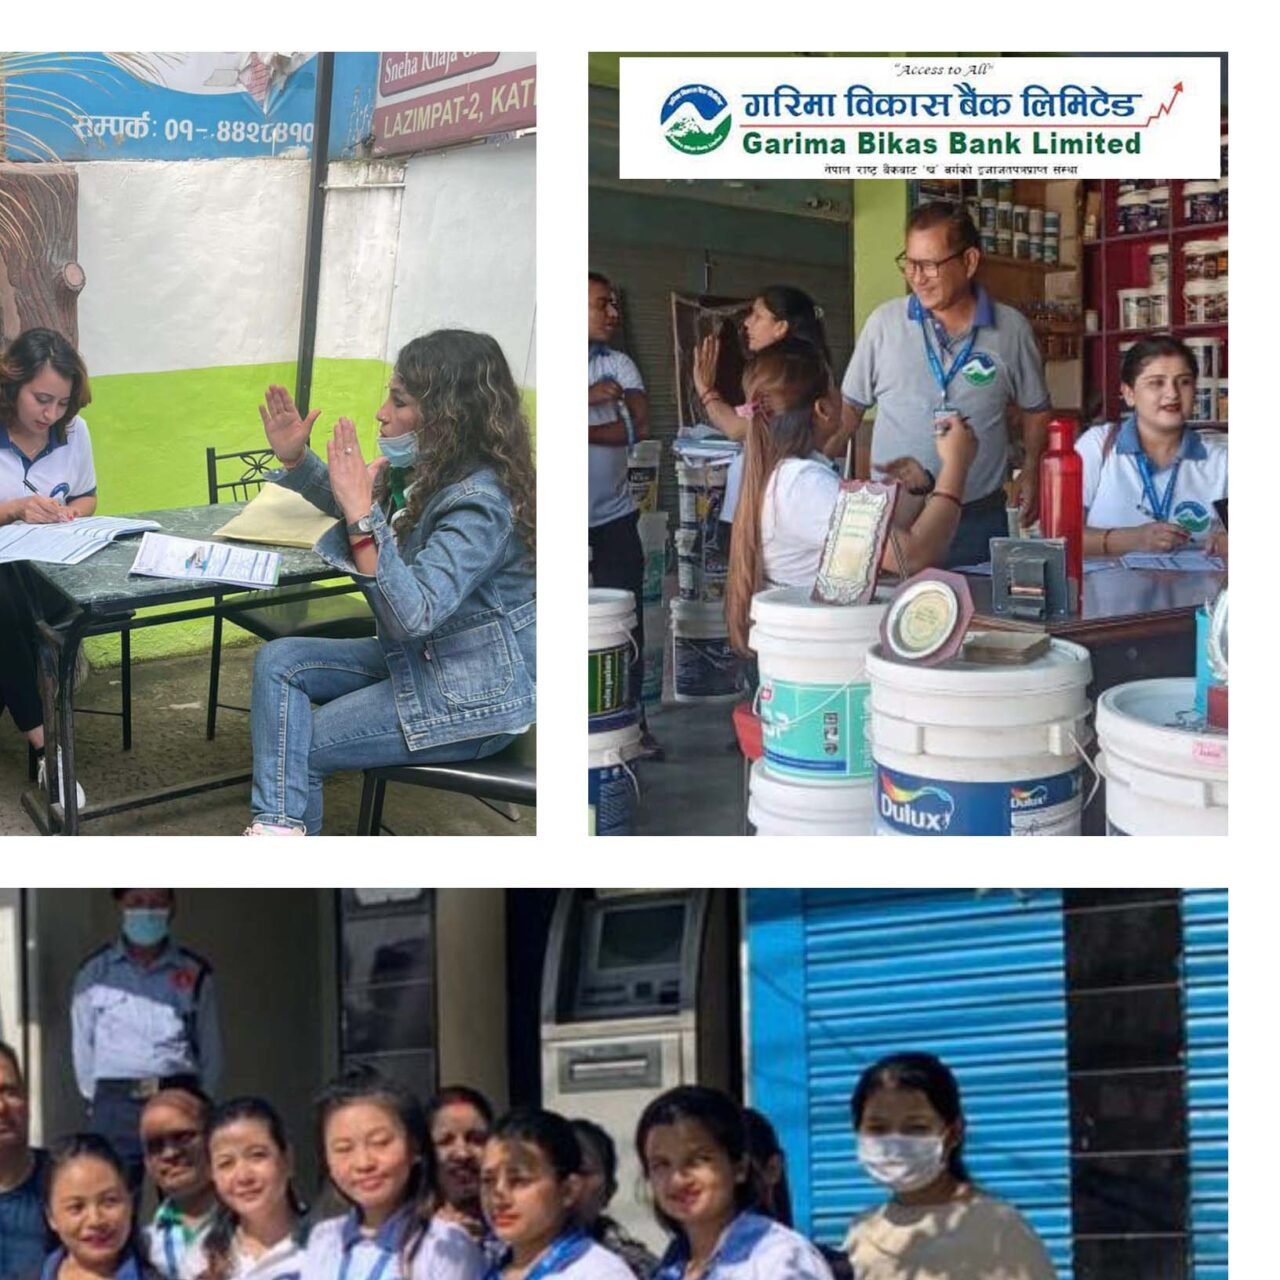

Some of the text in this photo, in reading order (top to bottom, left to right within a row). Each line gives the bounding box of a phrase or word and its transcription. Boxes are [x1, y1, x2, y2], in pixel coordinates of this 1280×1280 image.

[384, 56, 417, 83] Sneha
[383, 78, 536, 139] LAZIMPAT-2, KAT
[881, 793, 942, 831] Dulux
